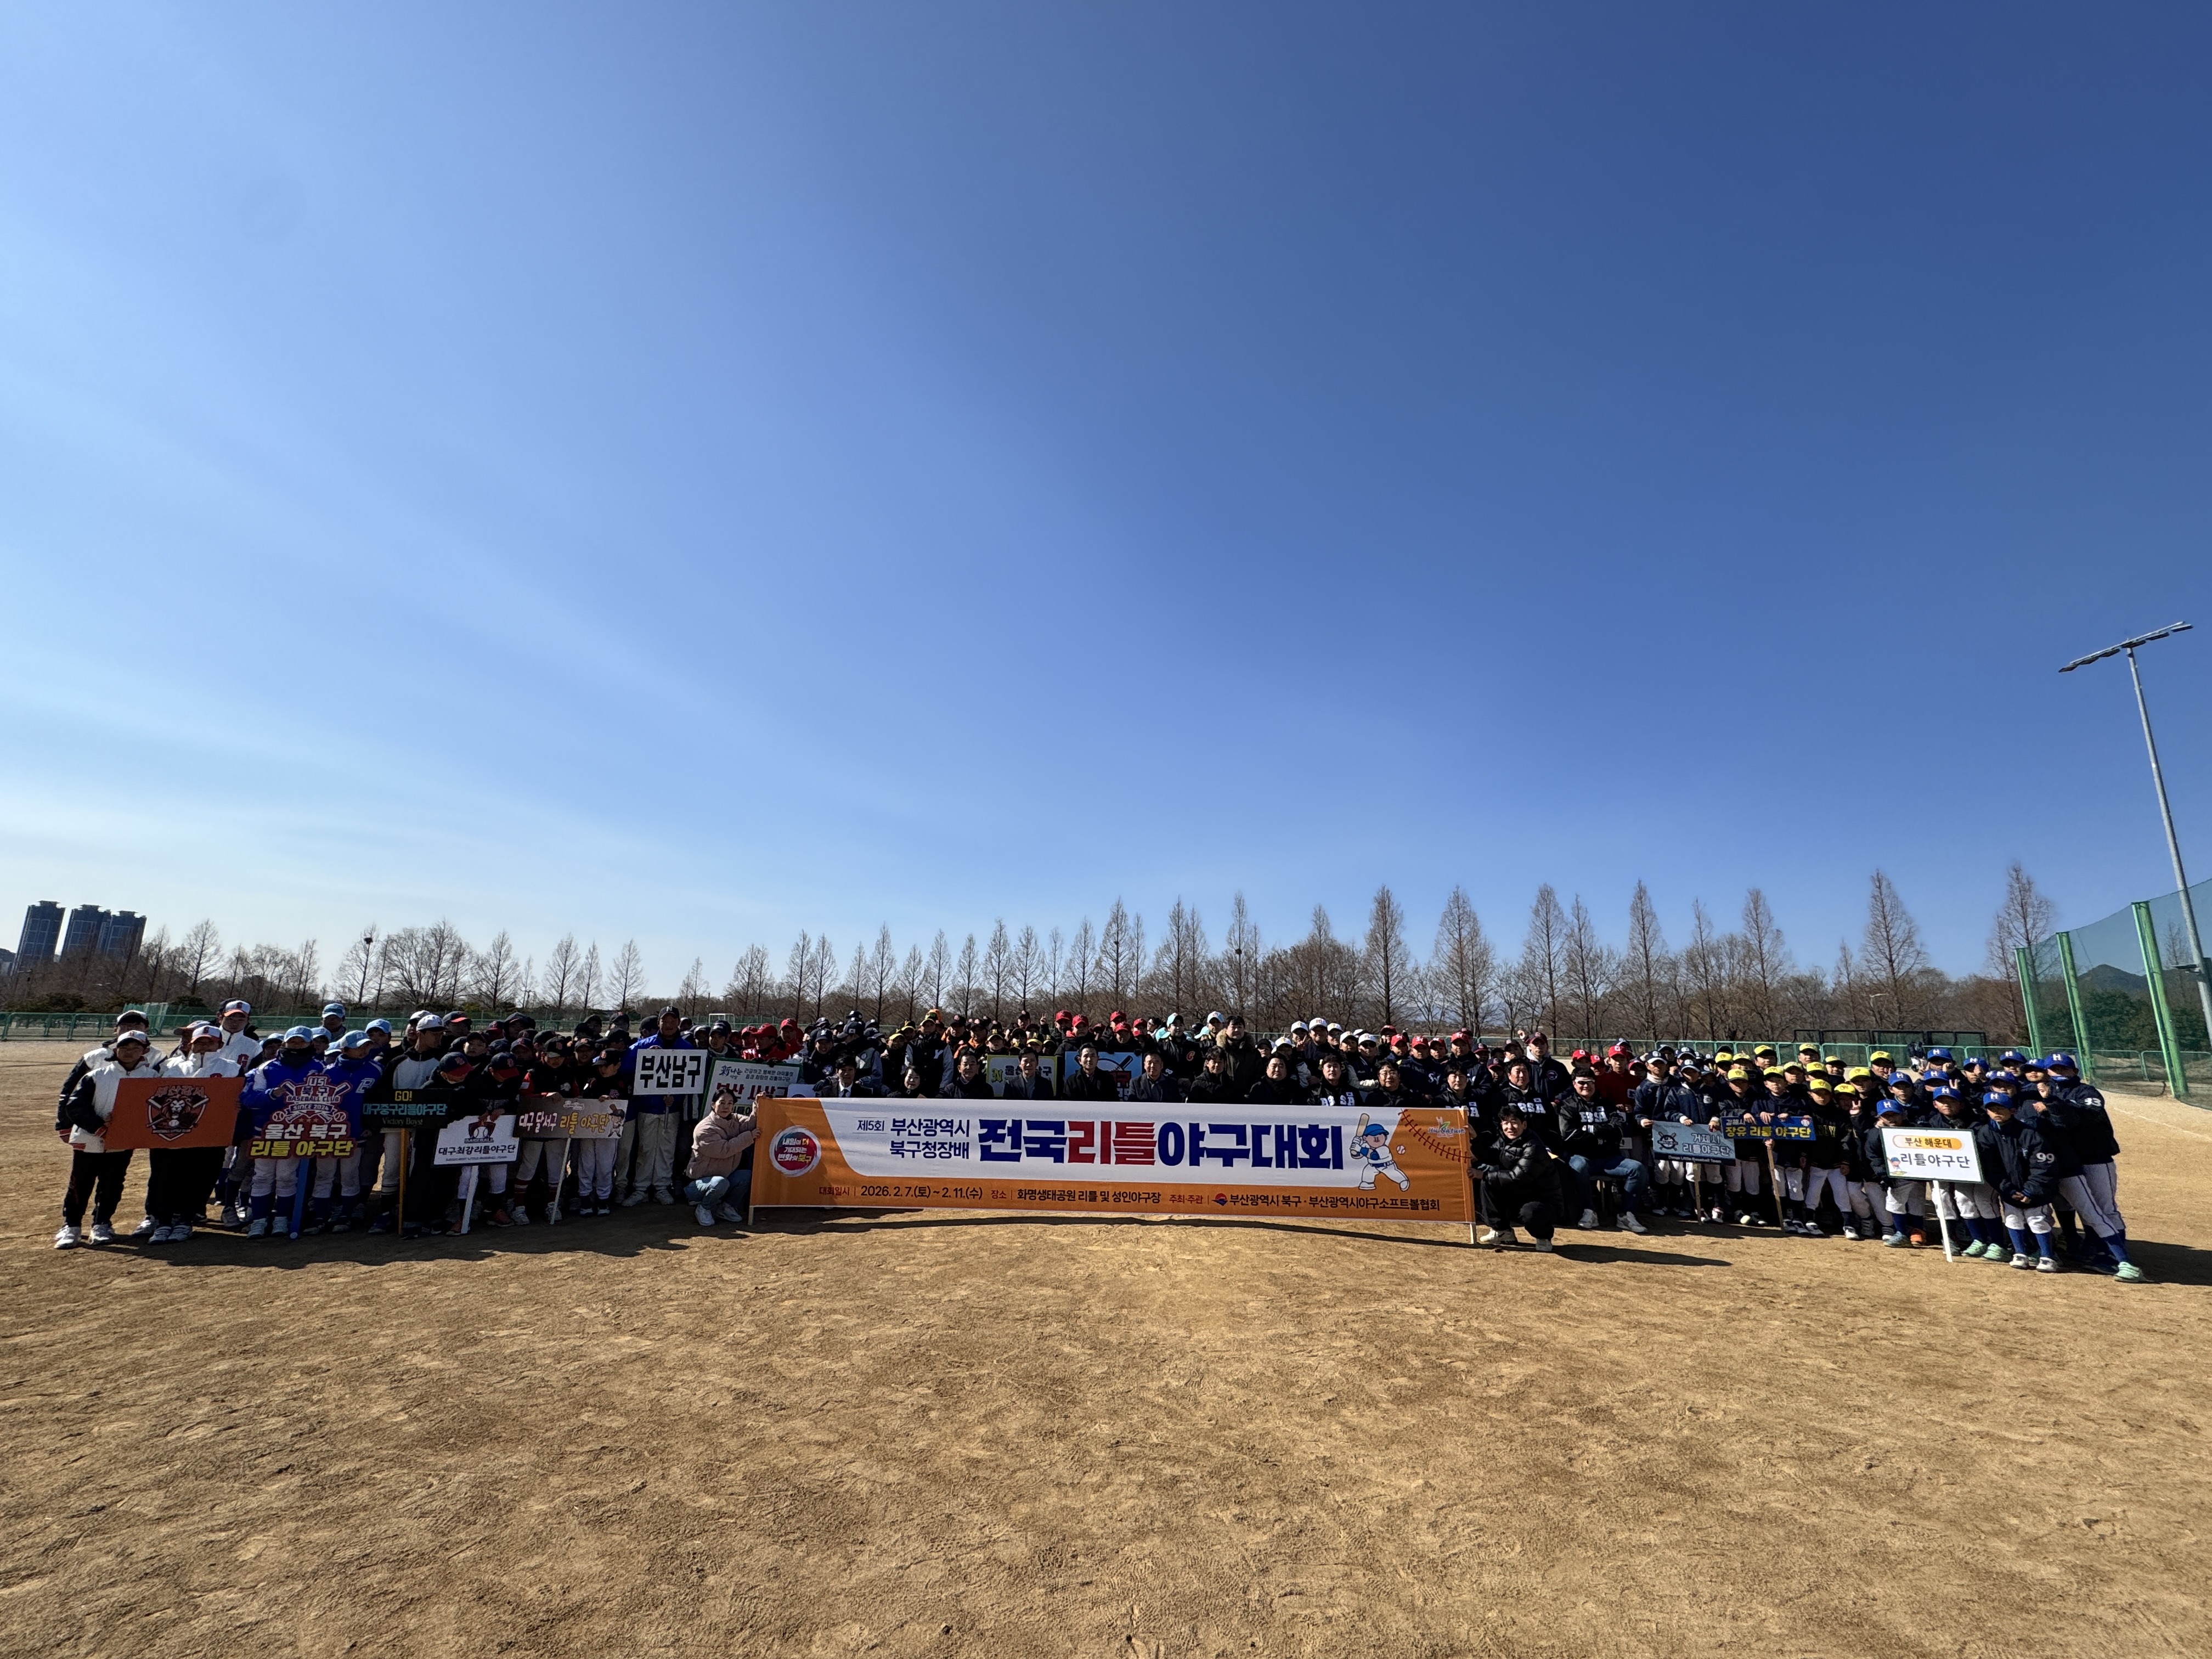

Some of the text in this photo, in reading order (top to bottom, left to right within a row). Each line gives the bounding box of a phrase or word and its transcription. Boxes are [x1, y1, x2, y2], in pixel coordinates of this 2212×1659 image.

[394, 1091, 413, 1102] GO!
[560, 1111, 579, 1135] 리틀
[580, 1113, 610, 1133] 야구단
[857, 1119, 970, 1137] 제5회 부산광역시
[265, 1124, 347, 1139] 울산 북구
[1691, 1133, 1721, 1144] 거제시
[1725, 1126, 1747, 1137] 장유
[1750, 1126, 1772, 1137] 리틀
[1775, 1126, 1812, 1138] 야구단
[250, 1141, 354, 1156] 리틀 야구단
[890, 1119, 1344, 1170] 북구청장배 전국리틀야구대회
[1682, 1143, 1730, 1157] 리틀야구단
[1905, 1137, 1953, 1148] 부산 해운대
[1900, 1153, 1970, 1168] 리틀야구단
[2036, 1152, 2055, 1164] 99
[819, 1186, 850, 1196] 대회일시
[991, 1189, 1161, 1204] 장소 화명생태공원 리틀 및 성인야구장
[1229, 1194, 1279, 1207] 부산광역시
[1281, 1195, 1302, 1207] 북구
[1308, 1196, 1440, 1211] 부산광역시야구소프트볼협회
